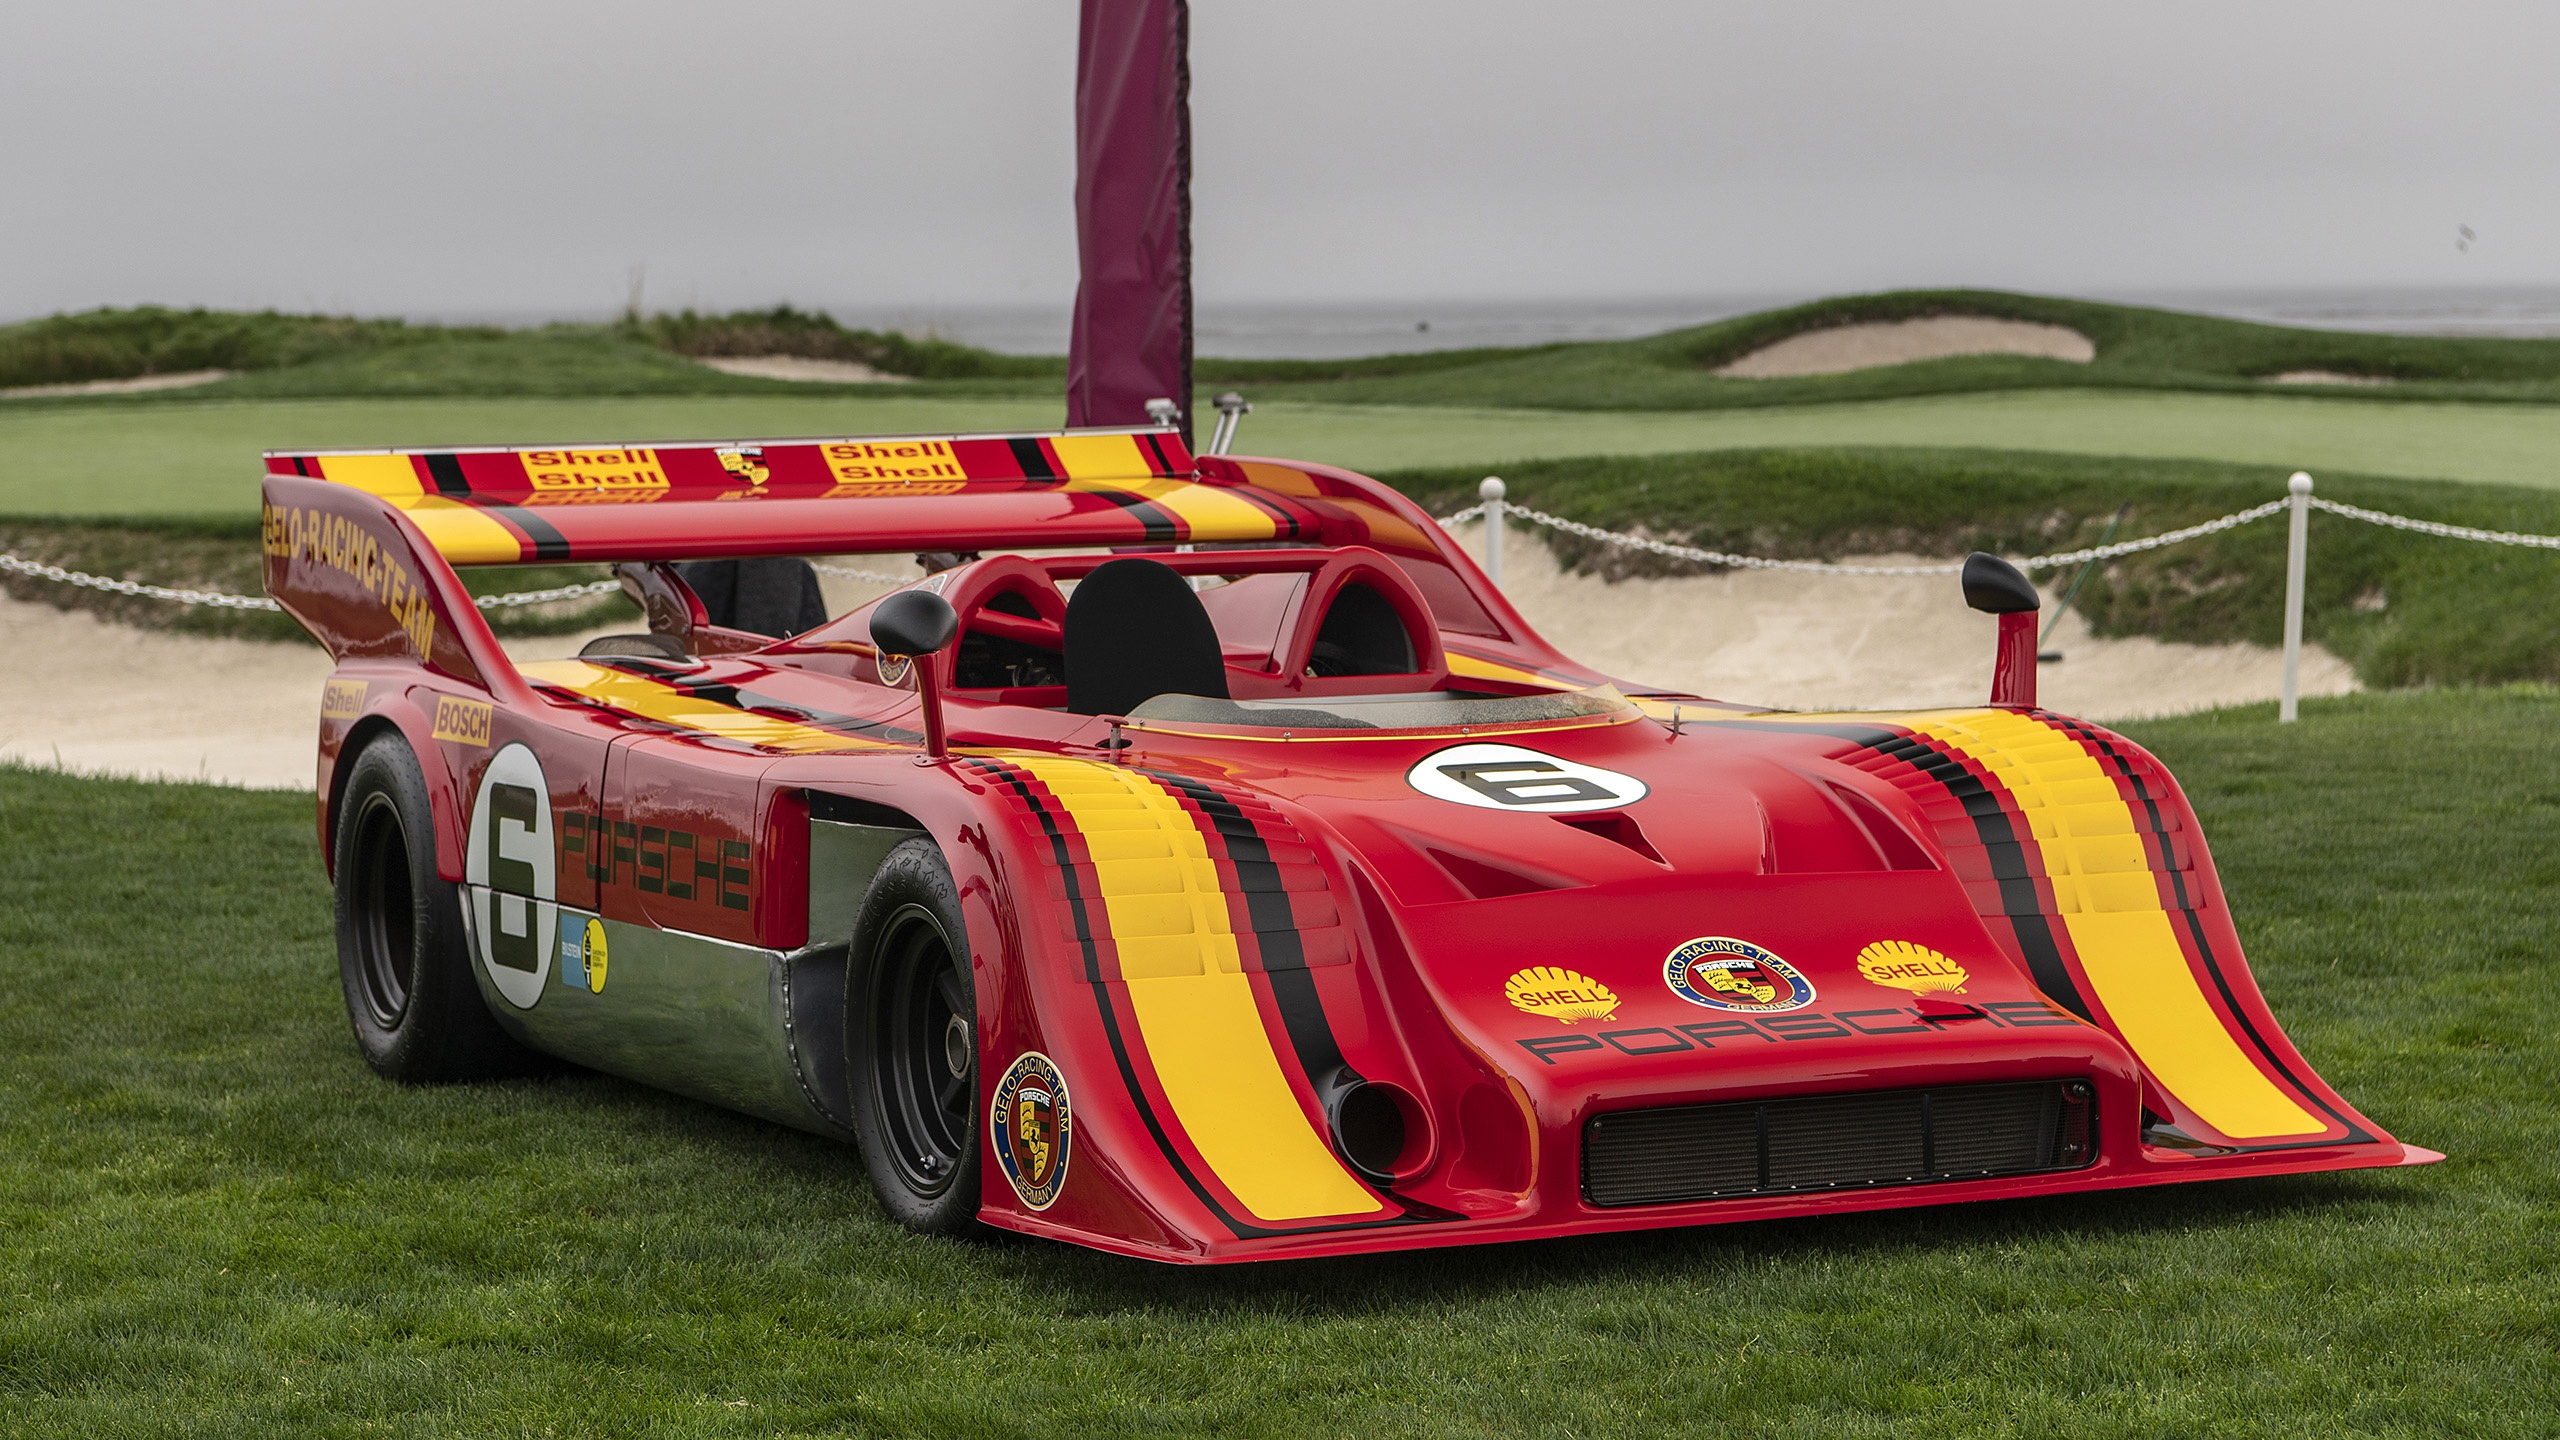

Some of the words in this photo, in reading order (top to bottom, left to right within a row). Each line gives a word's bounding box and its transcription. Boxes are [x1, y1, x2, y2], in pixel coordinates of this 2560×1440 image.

[529, 450, 649, 466] Shell
[829, 443, 946, 459] Shell
[537, 472, 660, 486] Shell
[840, 464, 957, 479] Shell
[325, 686, 365, 714] Shell
[437, 702, 491, 740] BOSCH
[1435, 761, 1621, 805] 6
[561, 810, 750, 912] PORSCHE
[489, 781, 539, 975] 6
[1693, 960, 1757, 974] PORSCHE
[1870, 961, 1959, 980] SHELL
[1518, 988, 1611, 1007] SHELL
[1726, 998, 1803, 1012] GERMANY
[1516, 1001, 2082, 1066] PORSCHE
[1019, 1091, 1051, 1108] PORSCHE
[1015, 1175, 1054, 1205] GERMANY
